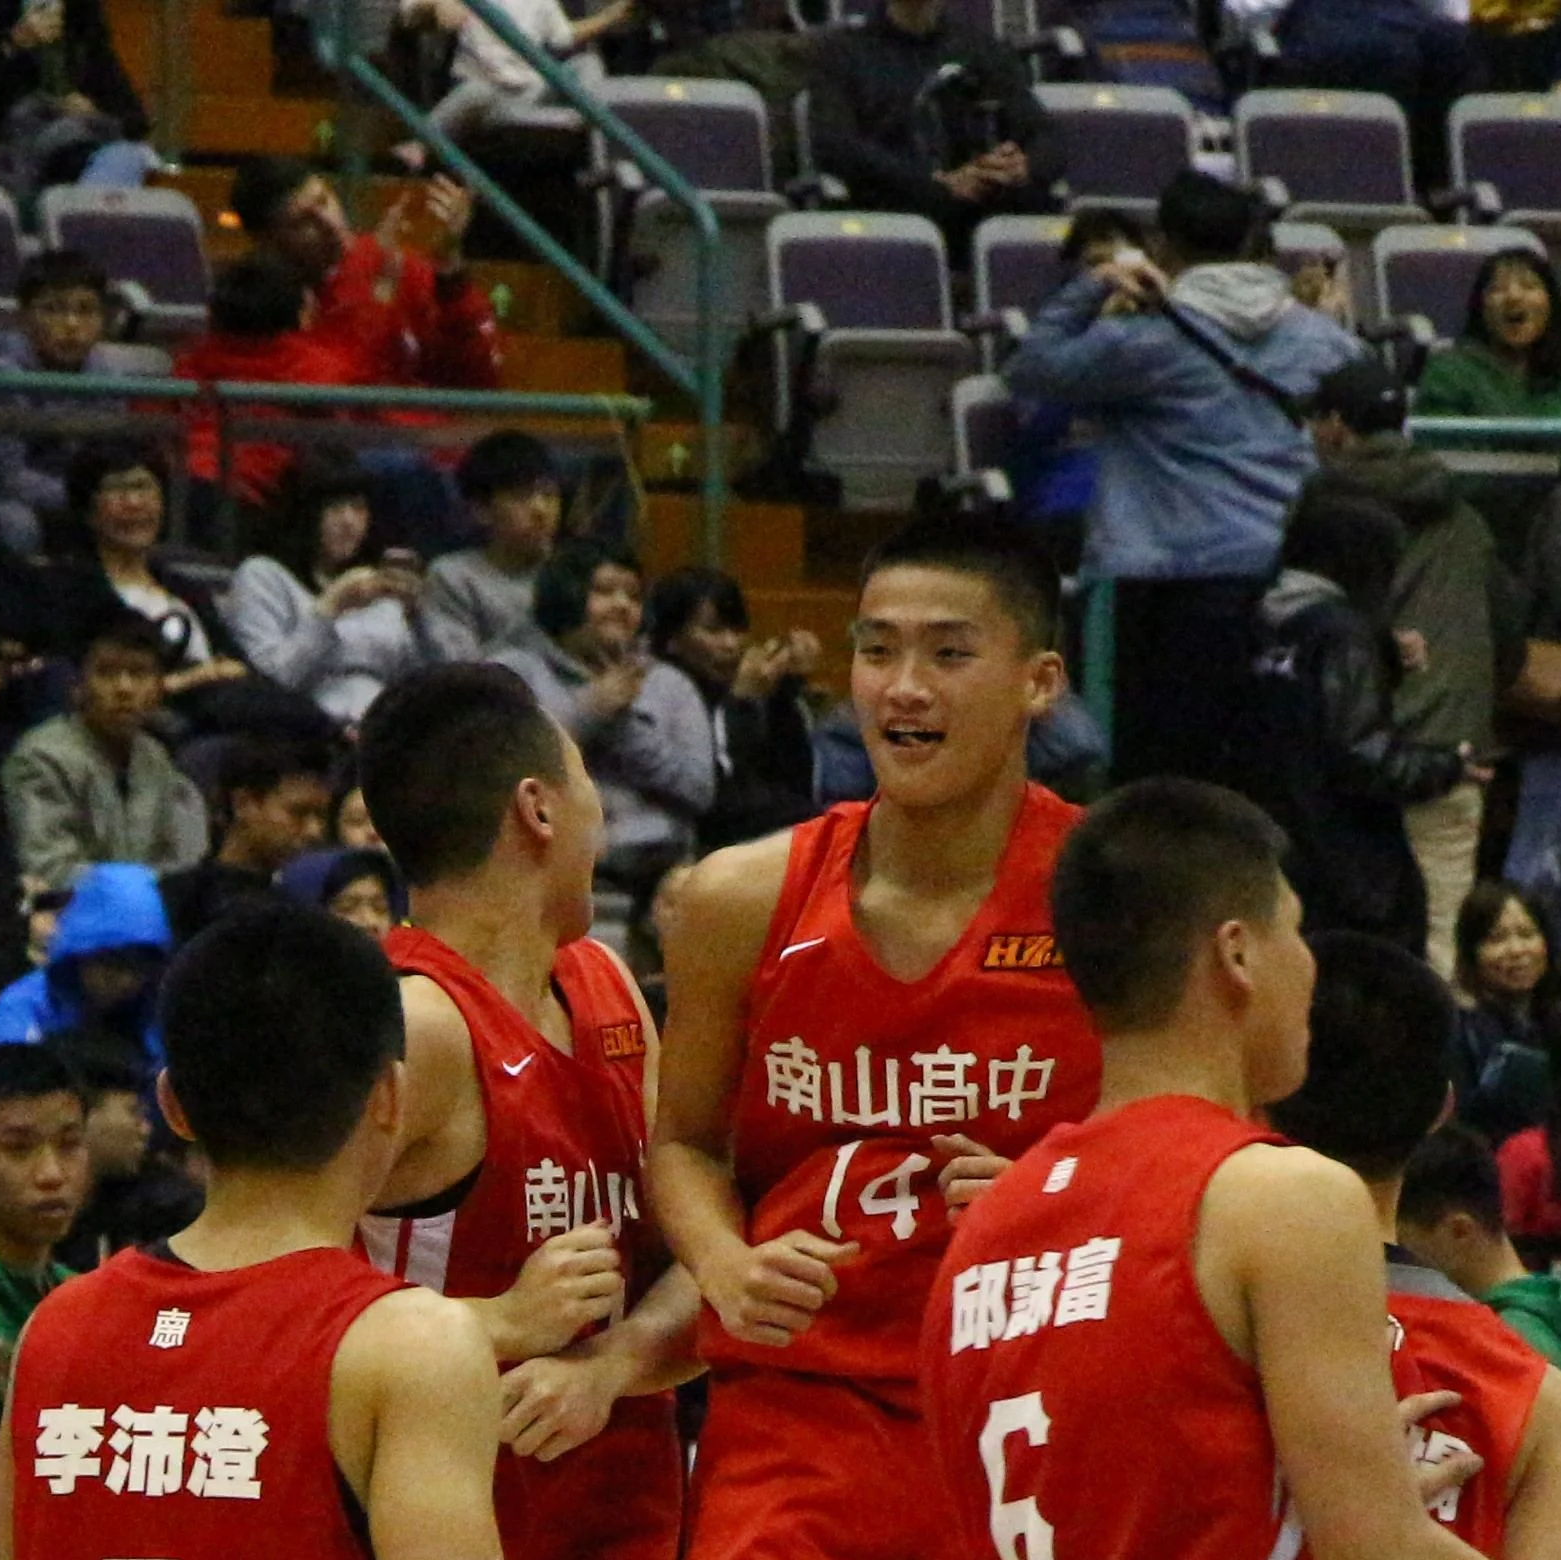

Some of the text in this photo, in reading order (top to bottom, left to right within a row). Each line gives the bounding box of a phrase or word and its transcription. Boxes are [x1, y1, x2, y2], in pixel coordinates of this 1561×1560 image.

[984, 935, 1065, 968] HB
[765, 1036, 1055, 1127] 南山高中
[821, 1140, 931, 1240] 14
